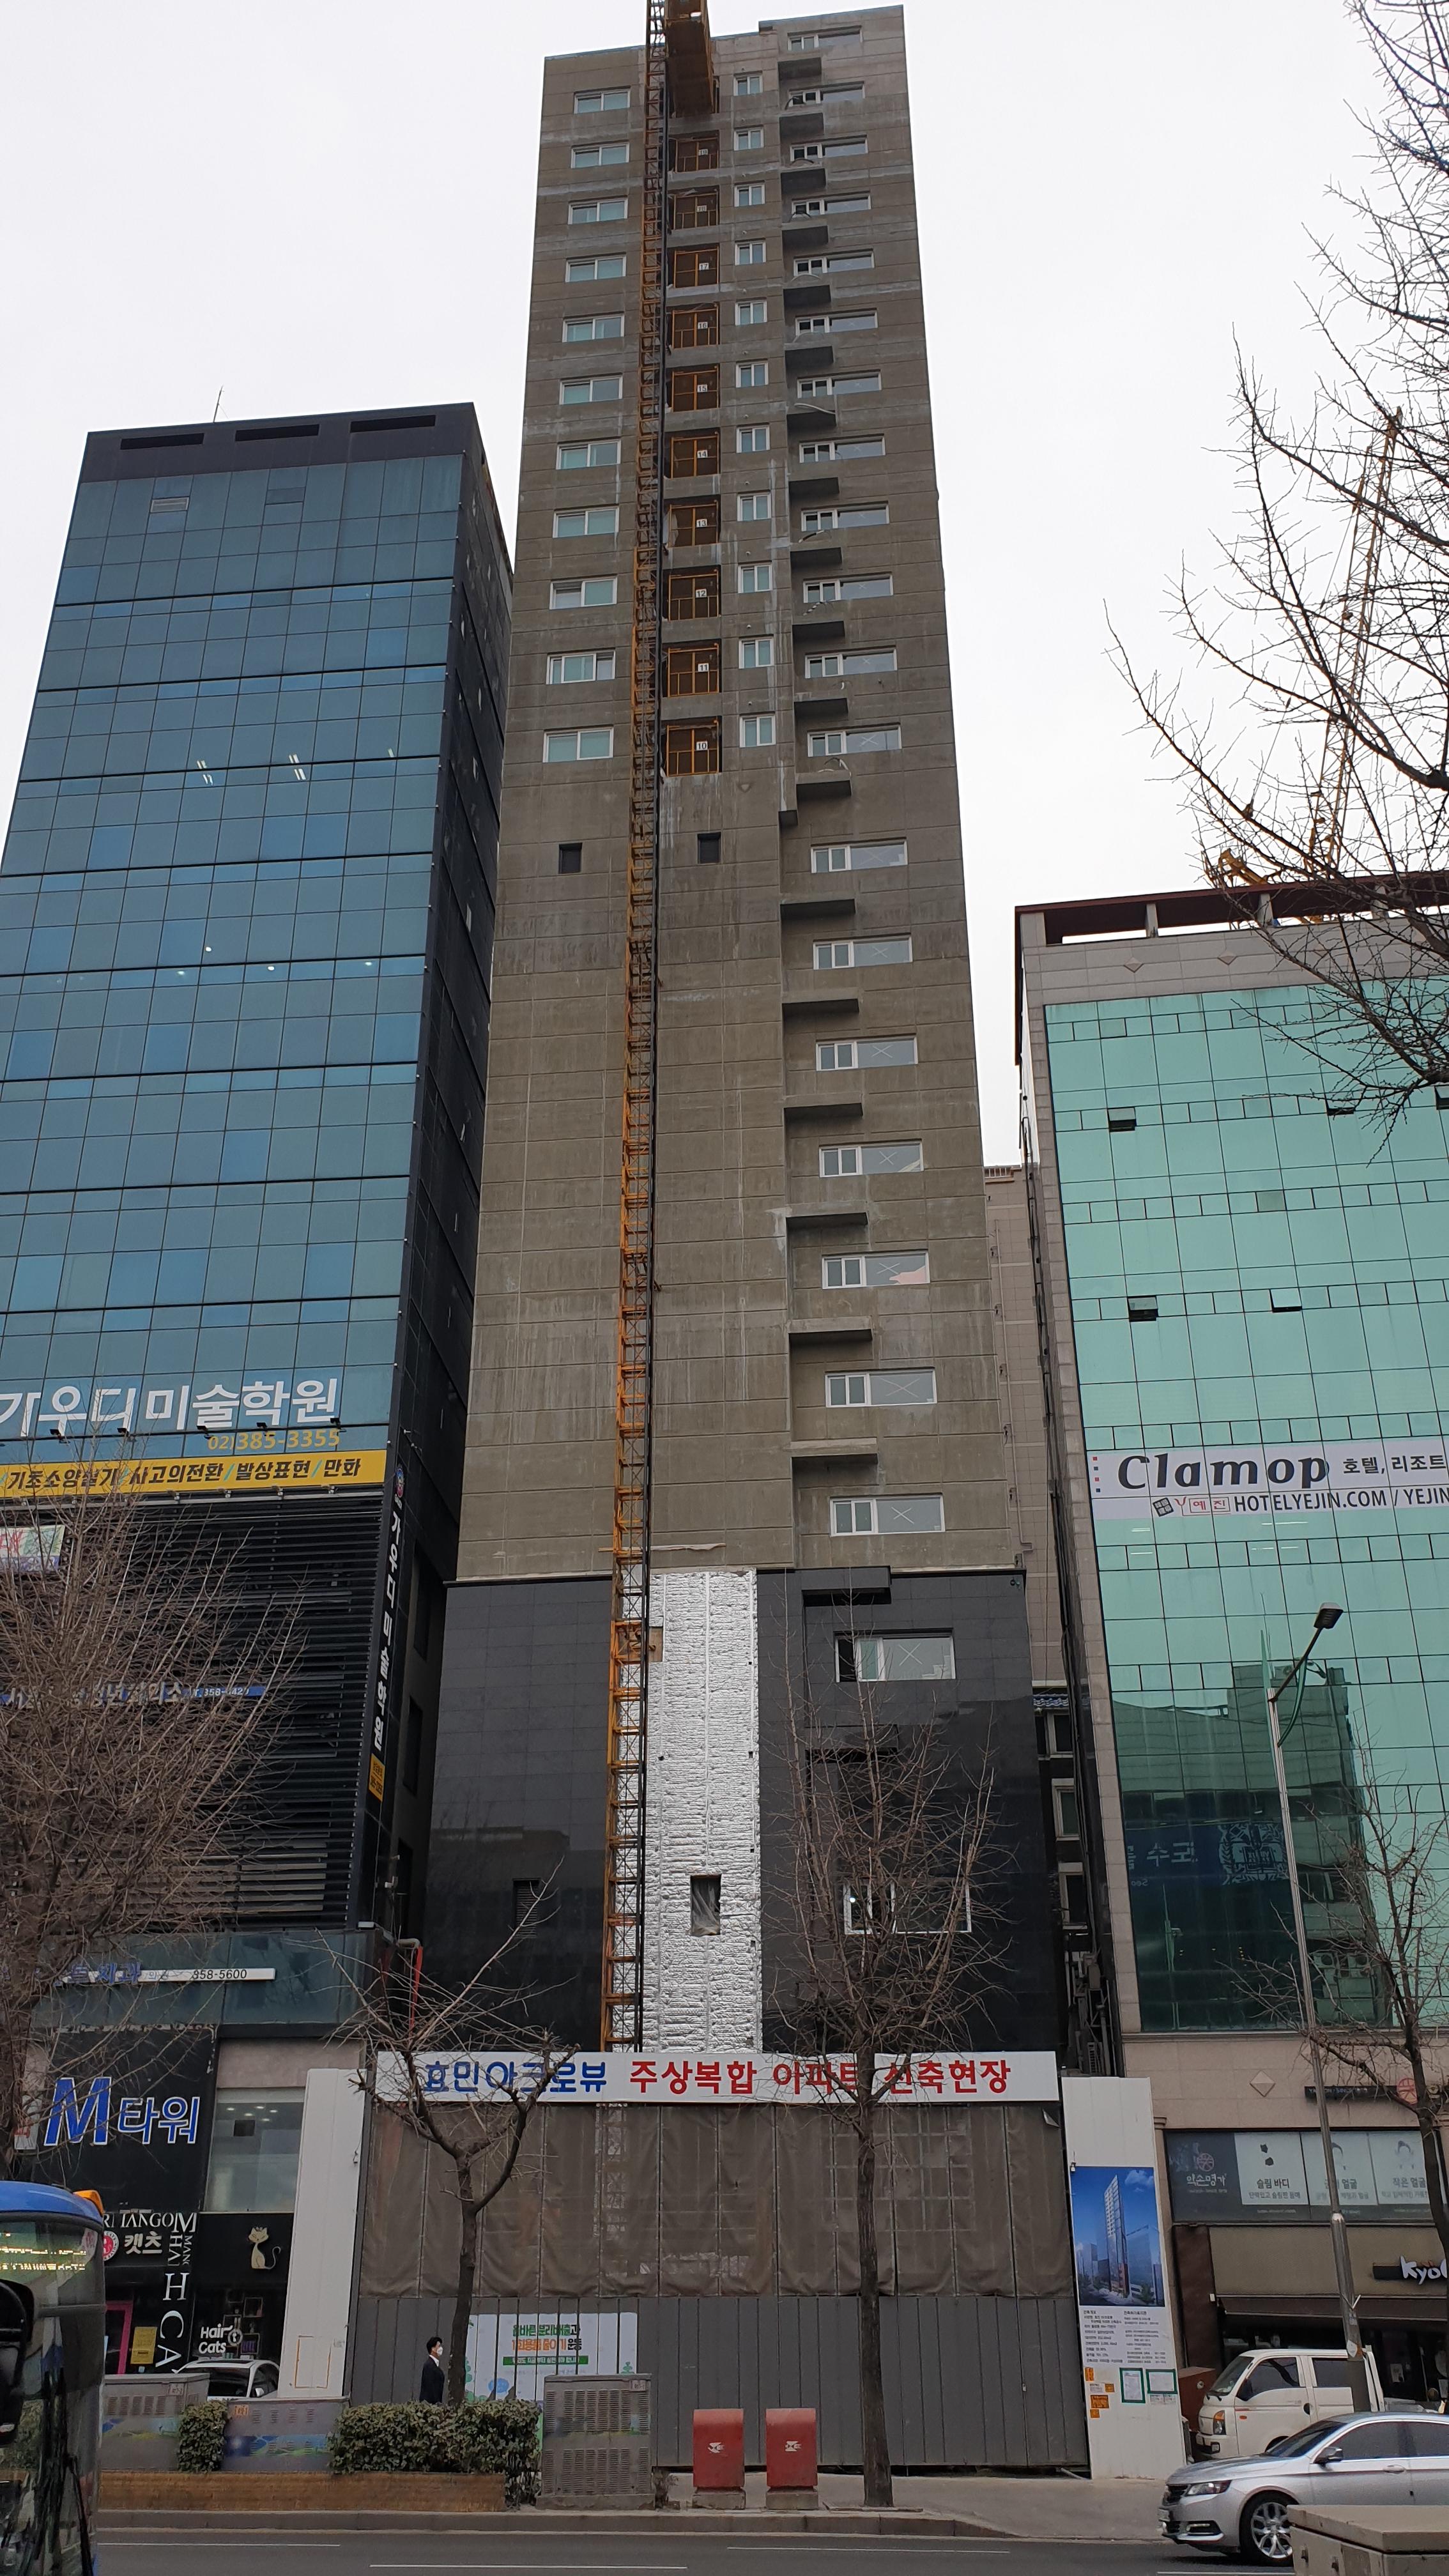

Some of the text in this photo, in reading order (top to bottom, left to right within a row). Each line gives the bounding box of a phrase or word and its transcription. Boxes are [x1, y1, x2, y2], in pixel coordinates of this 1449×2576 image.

[208, 1429, 341, 1450] 02)385-3355
[236, 1459, 310, 1482] 발상표현
[323, 1458, 361, 1478] 만화
[1117, 1453, 1330, 1489] Clamop
[1390, 1454, 1446, 1473] 리조트
[1234, 1489, 1386, 1512] HOTELYEJIN.COM
[423, 2060, 607, 2093] 효민아크로뷰
[629, 2060, 755, 2096] 주상복합
[884, 2058, 1011, 2094] 신축현장
[1186, 2174, 1226, 2188] 약손명가
[1256, 2179, 1290, 2189] 슬림 바디
[124, 2230, 163, 2255] 캣츠
[200, 2323, 233, 2339] Hair
[198, 2340, 227, 2354] Cats
